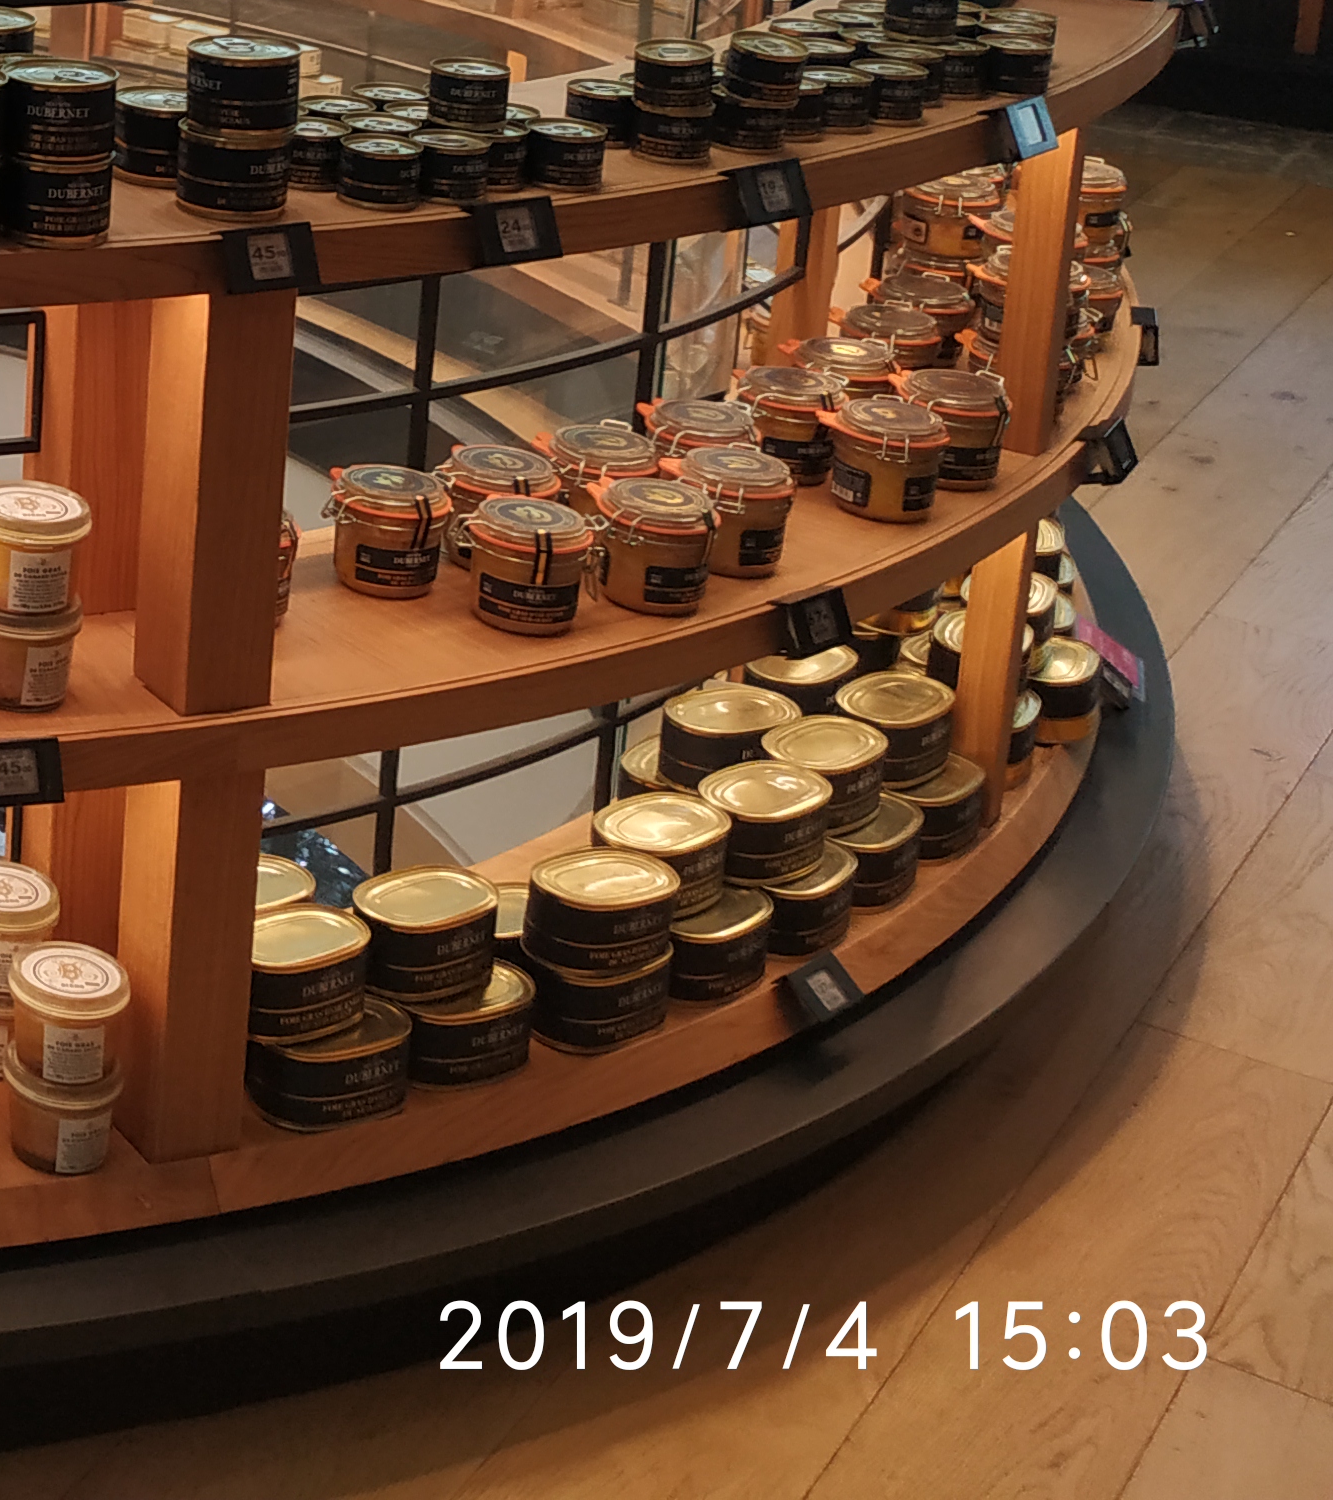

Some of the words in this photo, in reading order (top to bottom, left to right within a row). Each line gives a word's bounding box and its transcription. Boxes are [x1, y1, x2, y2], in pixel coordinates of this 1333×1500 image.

[27, 104, 90, 118] DUBERNET
[48, 185, 104, 199] DUBERNET
[252, 245, 275, 260] 45
[437, 932, 486, 955] DUBERNET
[302, 973, 354, 998] DUBERNET
[472, 1024, 524, 1047] DUBERNET
[345, 1061, 400, 1085] DUBERNET
